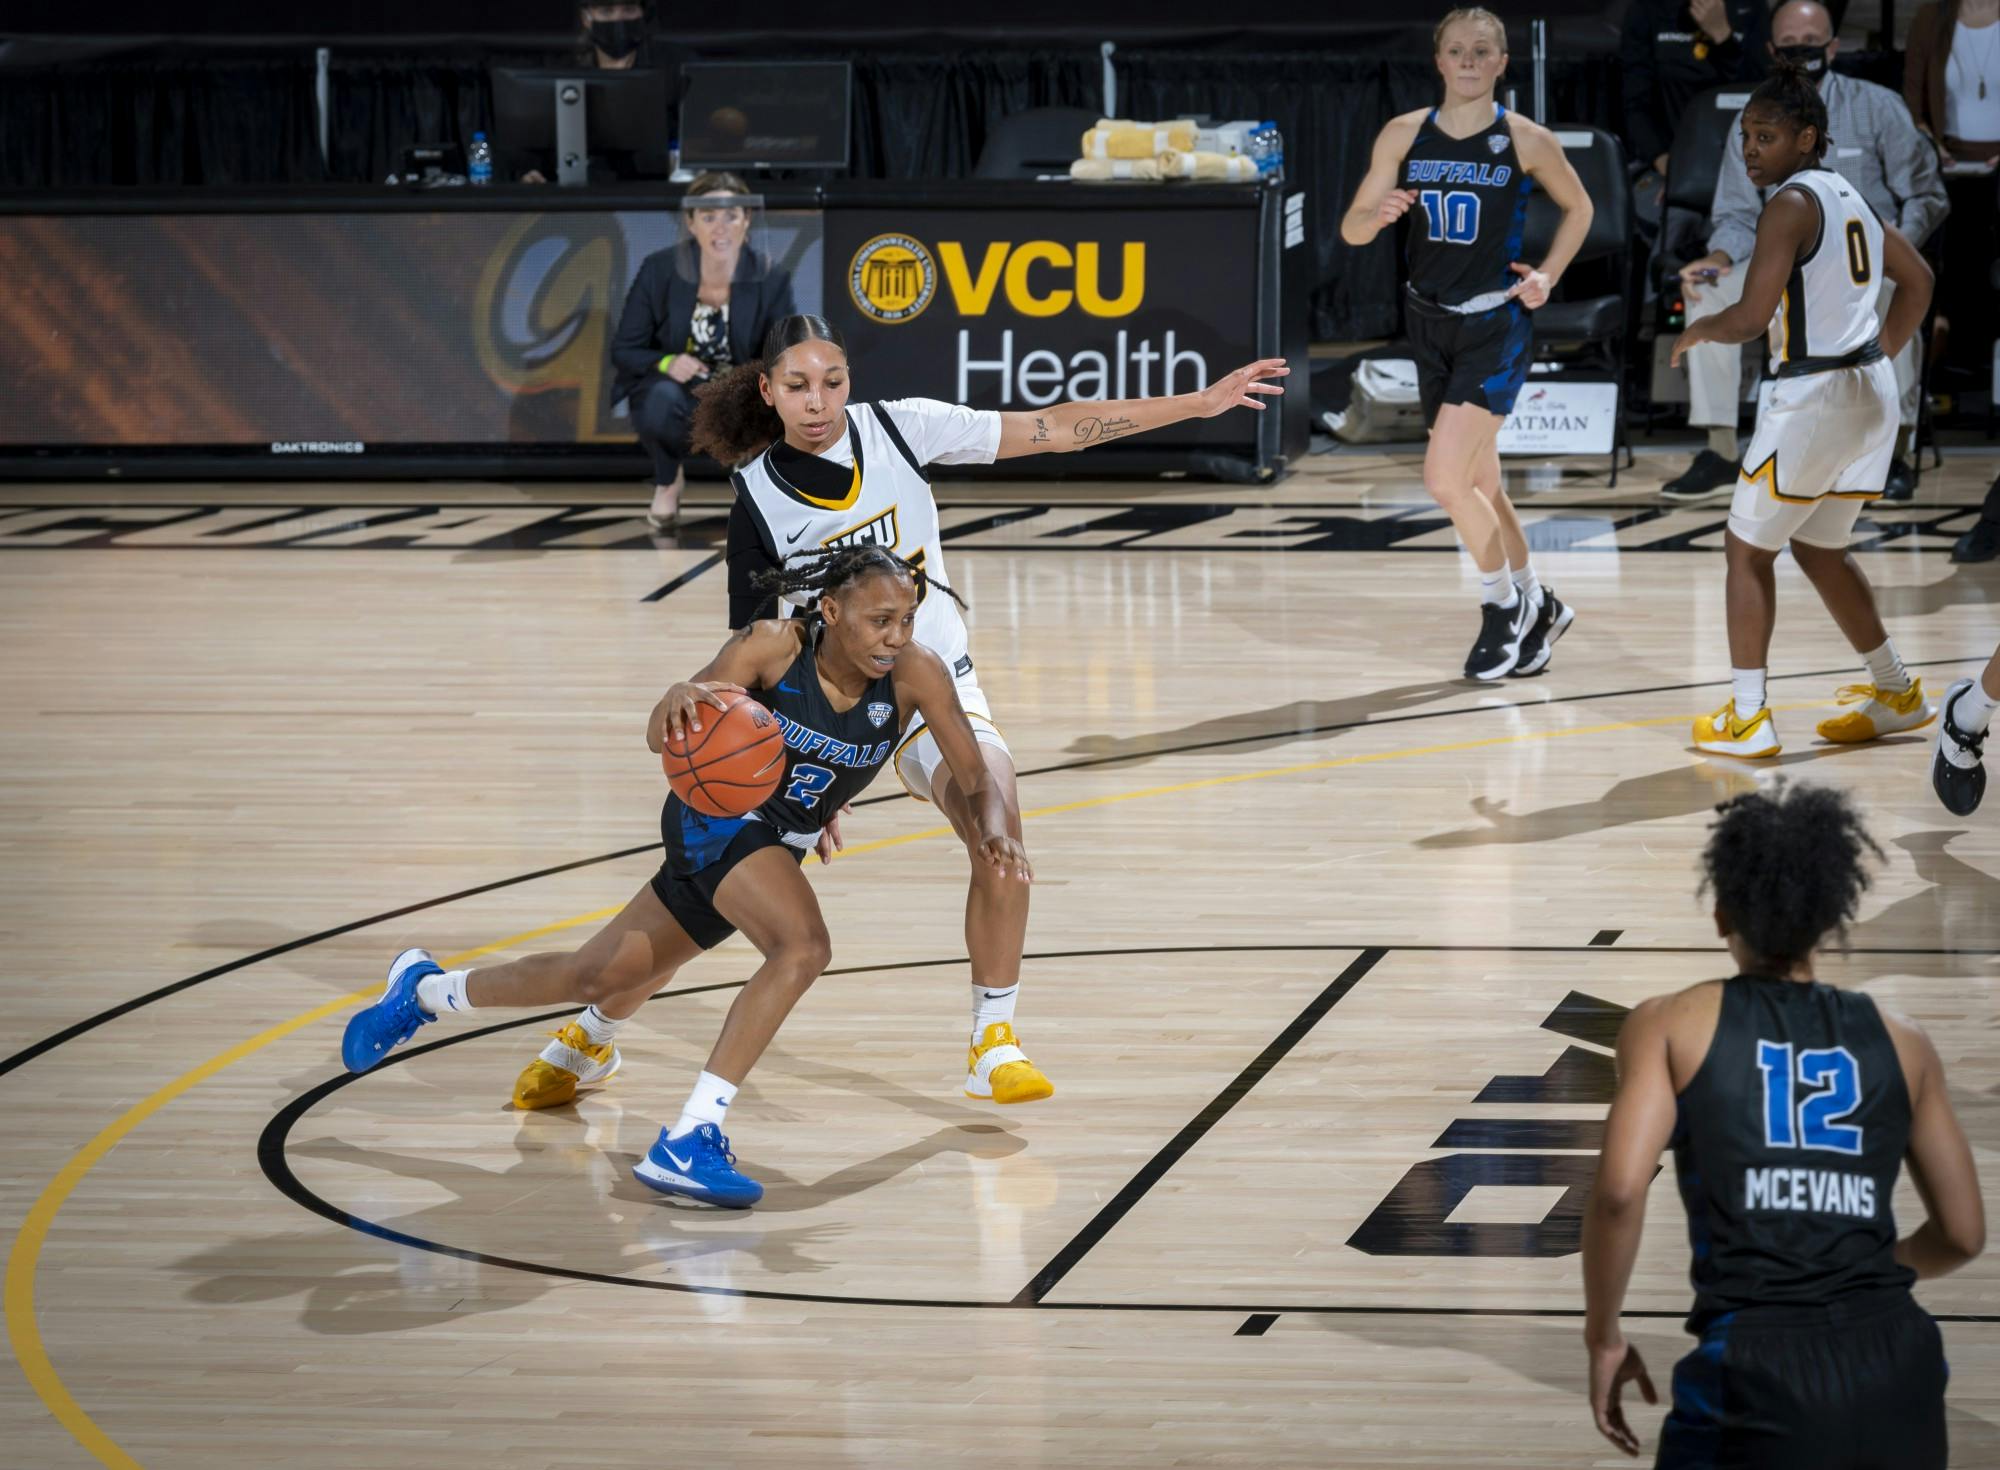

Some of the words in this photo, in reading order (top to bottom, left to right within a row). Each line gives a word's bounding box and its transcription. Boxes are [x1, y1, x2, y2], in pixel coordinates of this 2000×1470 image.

[1406, 159, 1512, 187] BUFFALO
[1420, 190, 1481, 245] 10
[1845, 216, 1872, 287] 0
[936, 239, 1147, 317] VCU
[957, 328, 1208, 406] Health
[271, 441, 365, 453] DAKTRONICS
[1502, 415, 1590, 430] ATMAN
[827, 512, 897, 550] CU
[784, 763, 837, 809] 2
[1756, 1038, 1864, 1156] 12
[1744, 1167, 1876, 1218] MCEVANS
